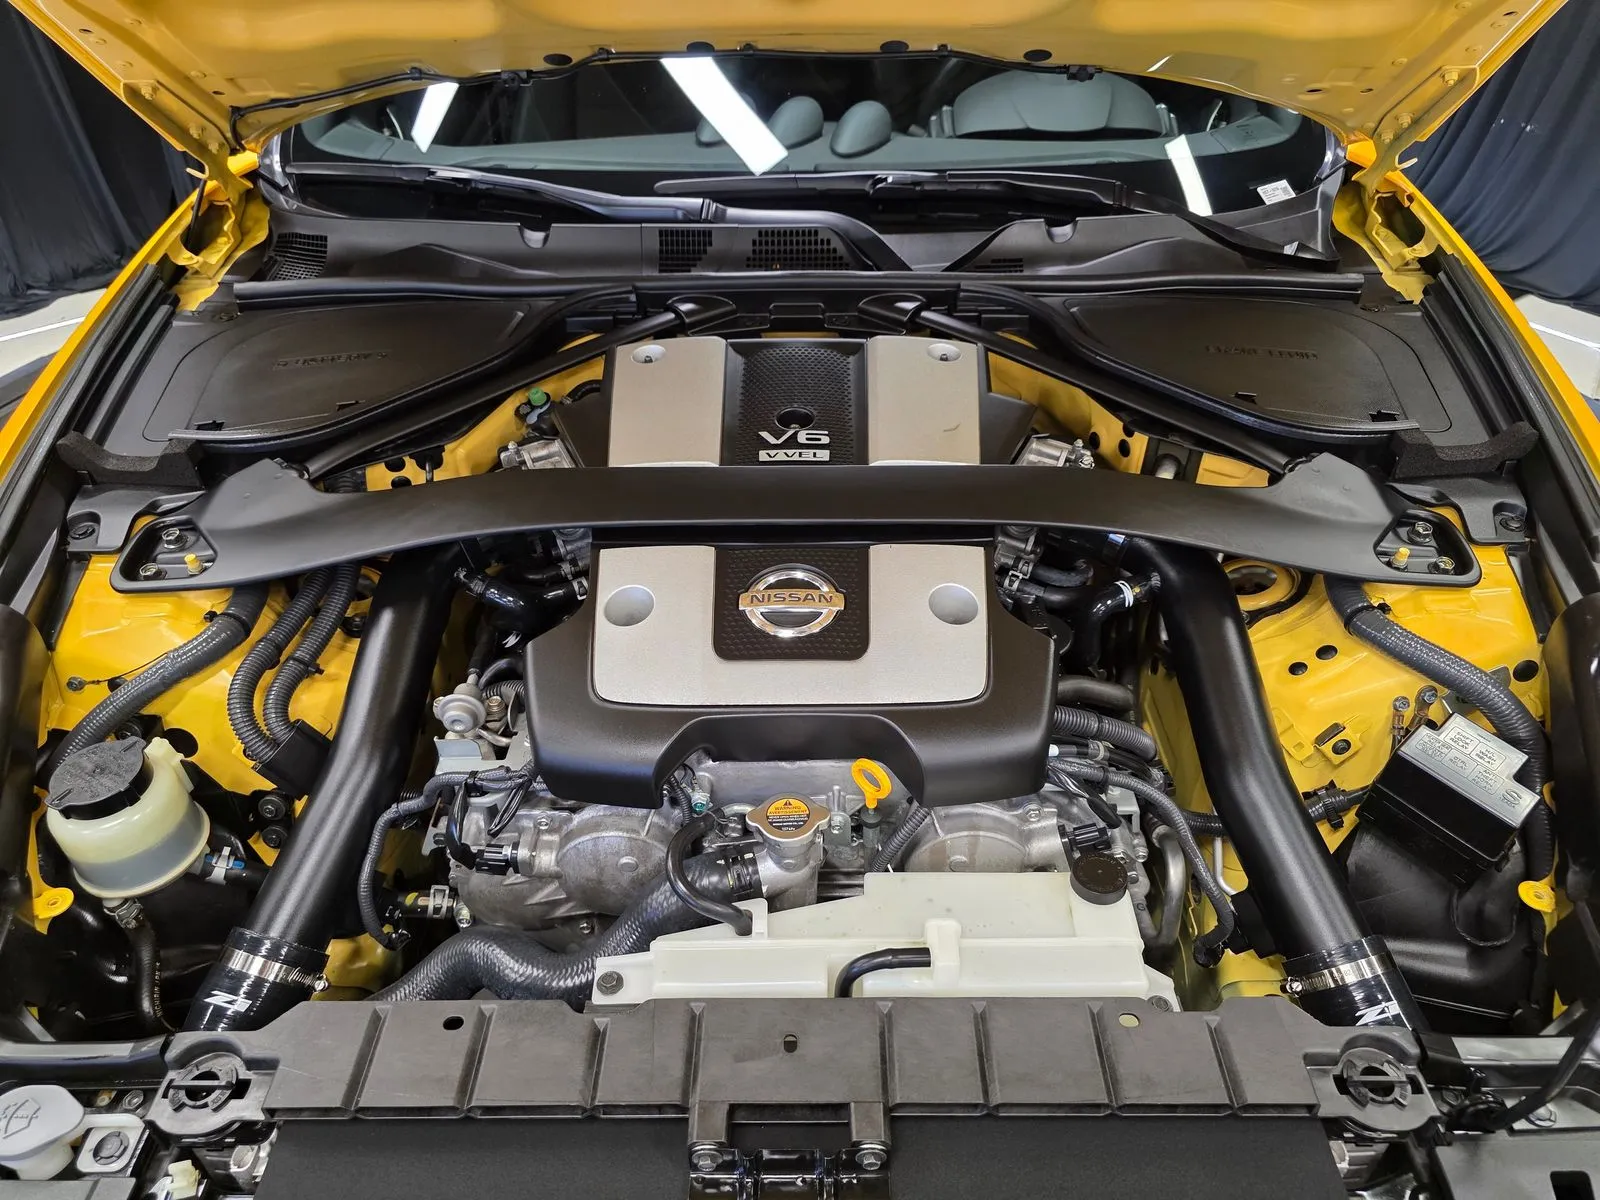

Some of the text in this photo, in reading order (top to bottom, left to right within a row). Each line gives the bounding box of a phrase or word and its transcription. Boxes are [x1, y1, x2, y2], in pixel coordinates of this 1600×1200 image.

[758, 430, 830, 444] V6
[750, 592, 833, 604] NISSAN
[1456, 731, 1473, 743] SHIFT
[1449, 737, 1468, 750] RELAY
[1474, 752, 1494, 766] RELAY
[1478, 750, 1496, 762] WASH
[1448, 758, 1466, 770] RELAY
